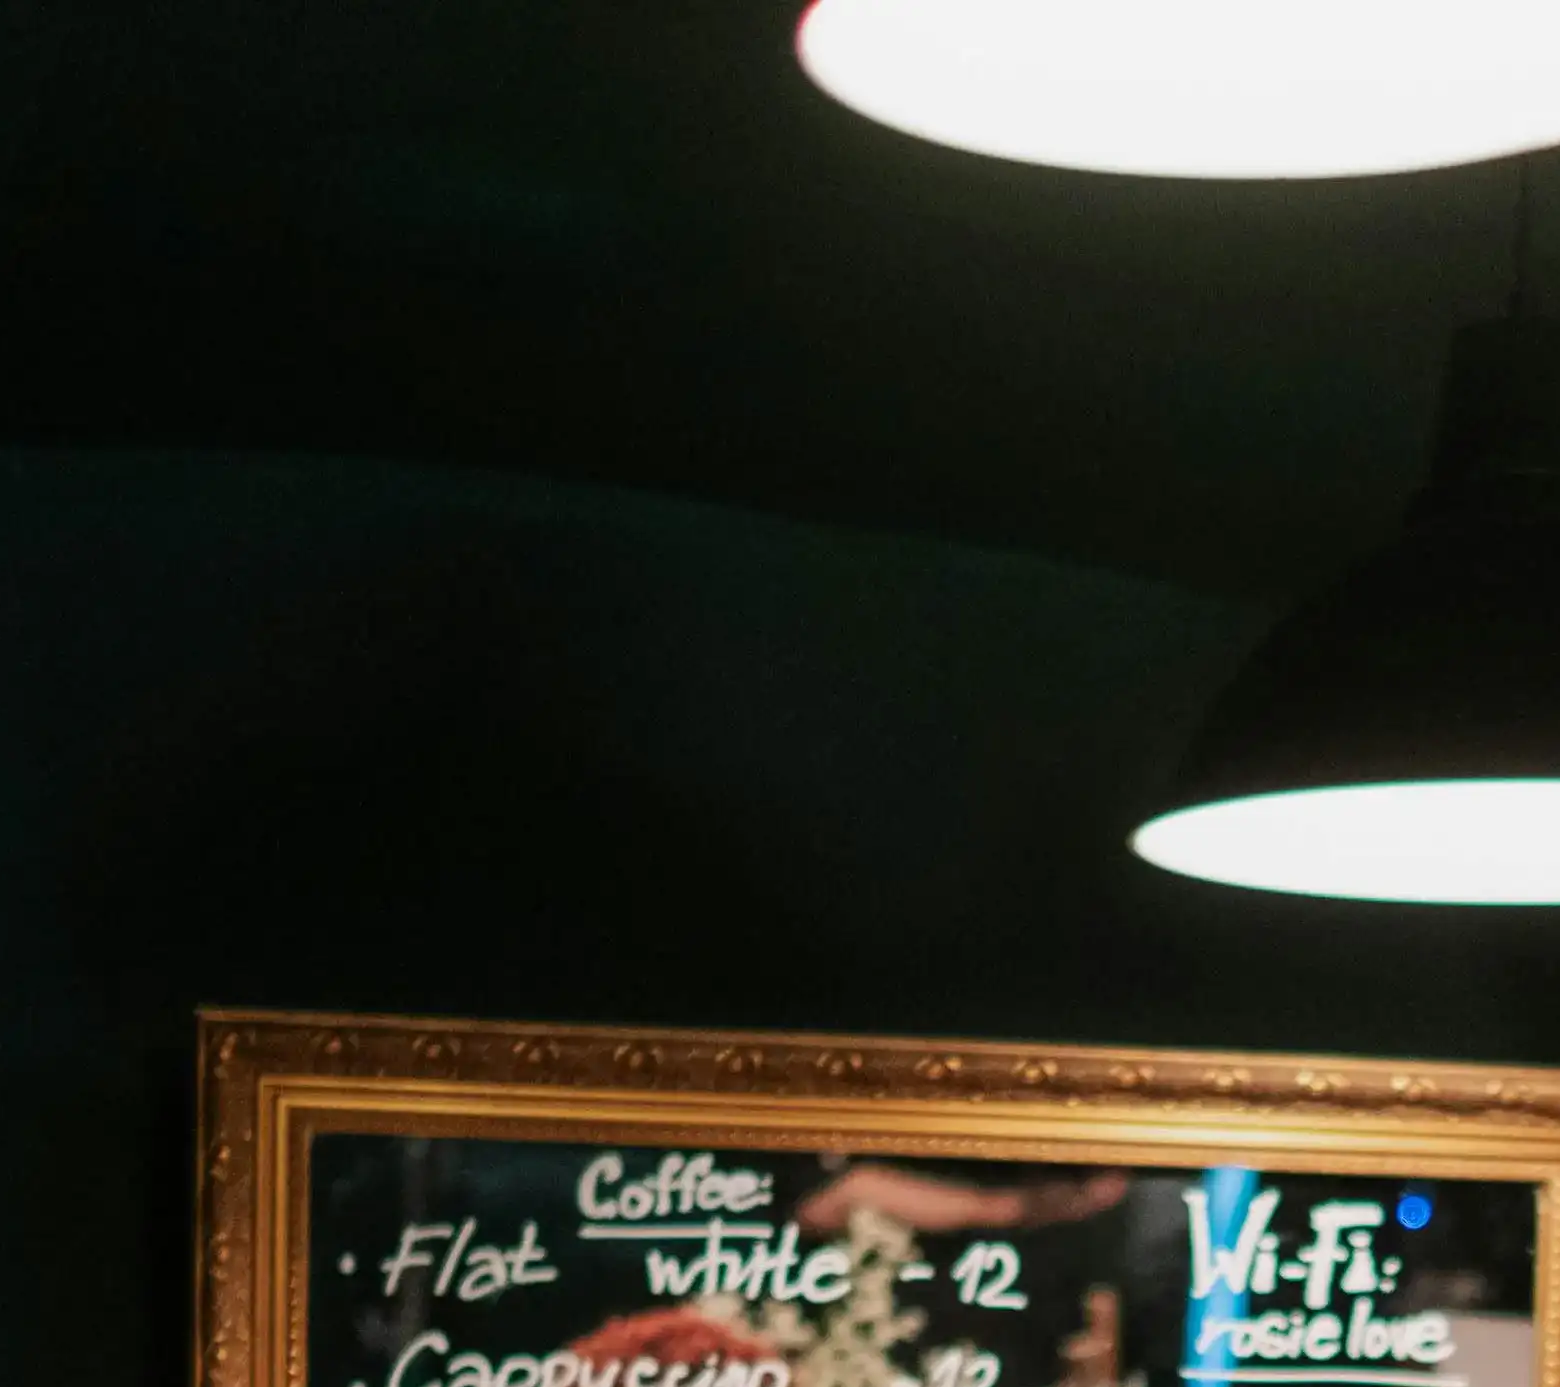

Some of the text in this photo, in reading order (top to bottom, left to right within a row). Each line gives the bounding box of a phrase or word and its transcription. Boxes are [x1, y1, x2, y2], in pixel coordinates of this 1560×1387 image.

[380, 1218, 559, 1301] Flat
[646, 1217, 853, 1303] white
[1182, 1188, 1402, 1310] Wi-Fi:
